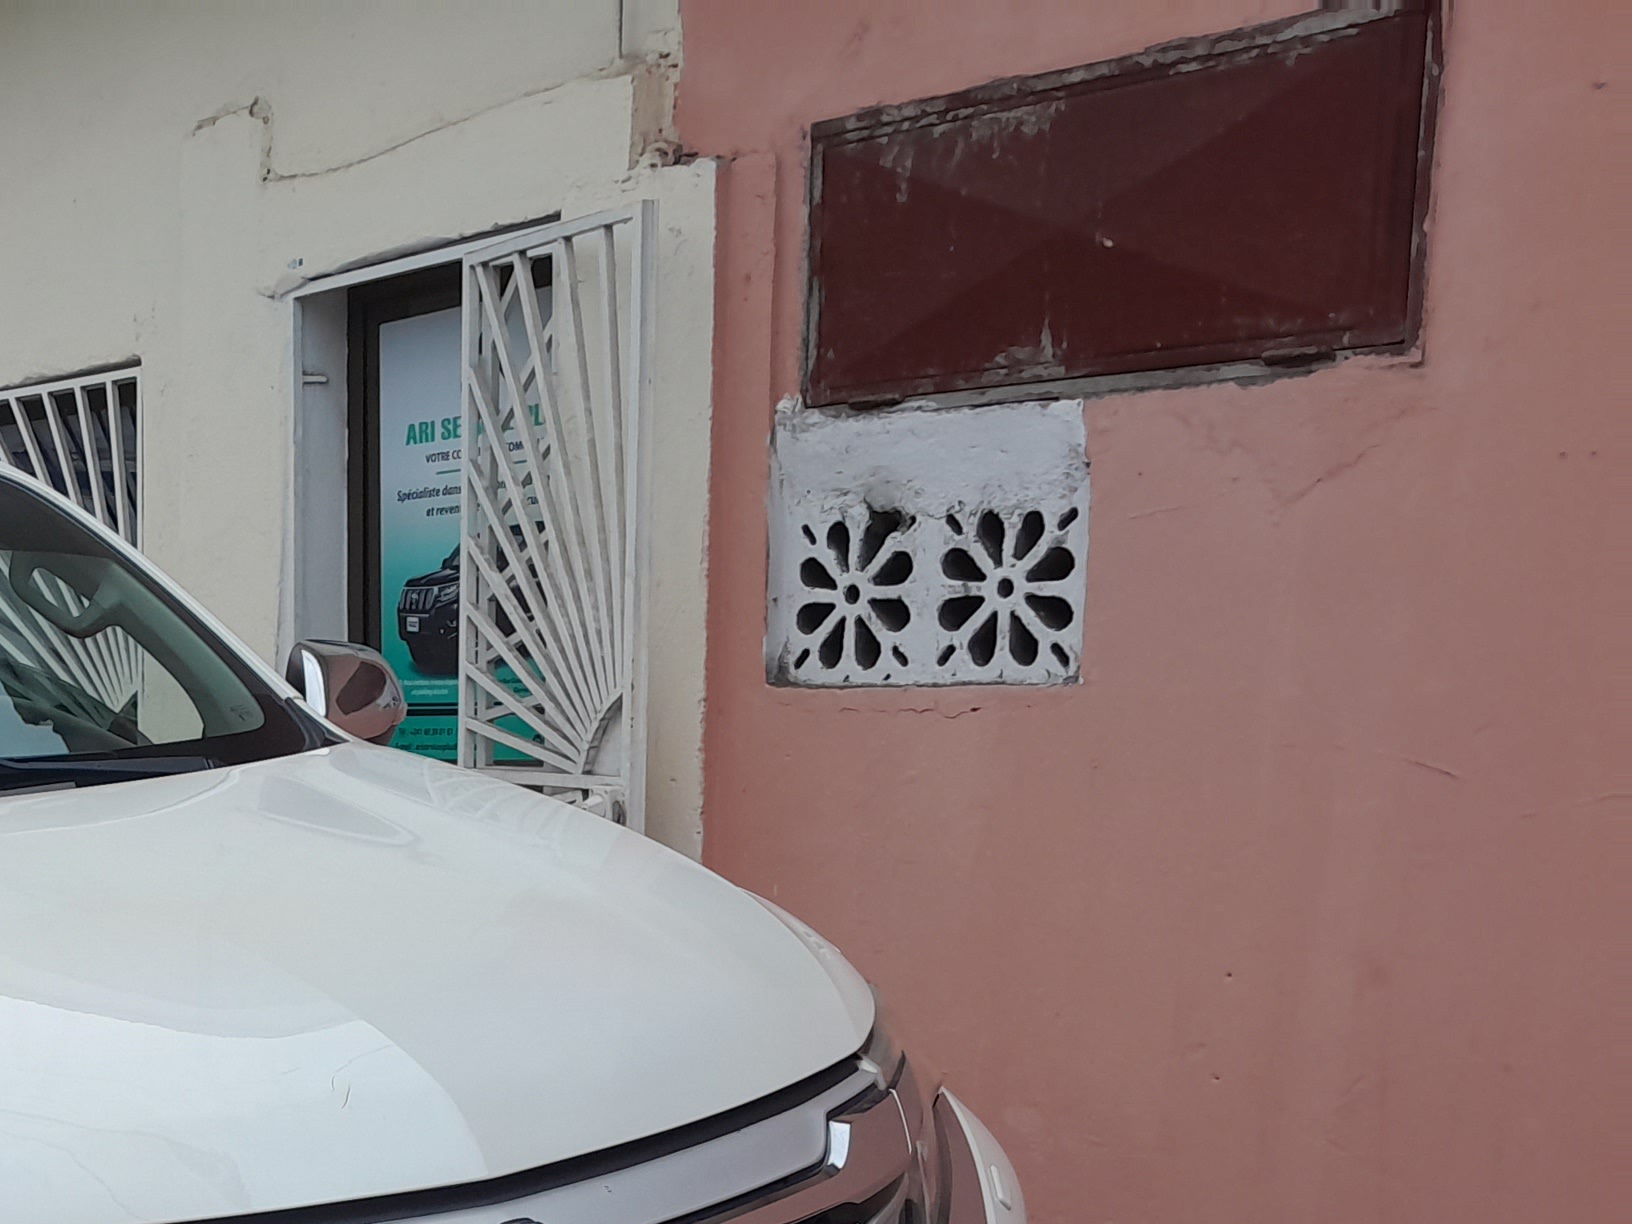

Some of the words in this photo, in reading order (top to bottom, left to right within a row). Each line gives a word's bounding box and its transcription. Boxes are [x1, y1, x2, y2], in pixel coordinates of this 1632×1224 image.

[405, 421, 435, 446] ARI
[425, 450, 450, 463] VOTRE
[396, 486, 441, 504] Spécialiste
[425, 505, 434, 517] et
